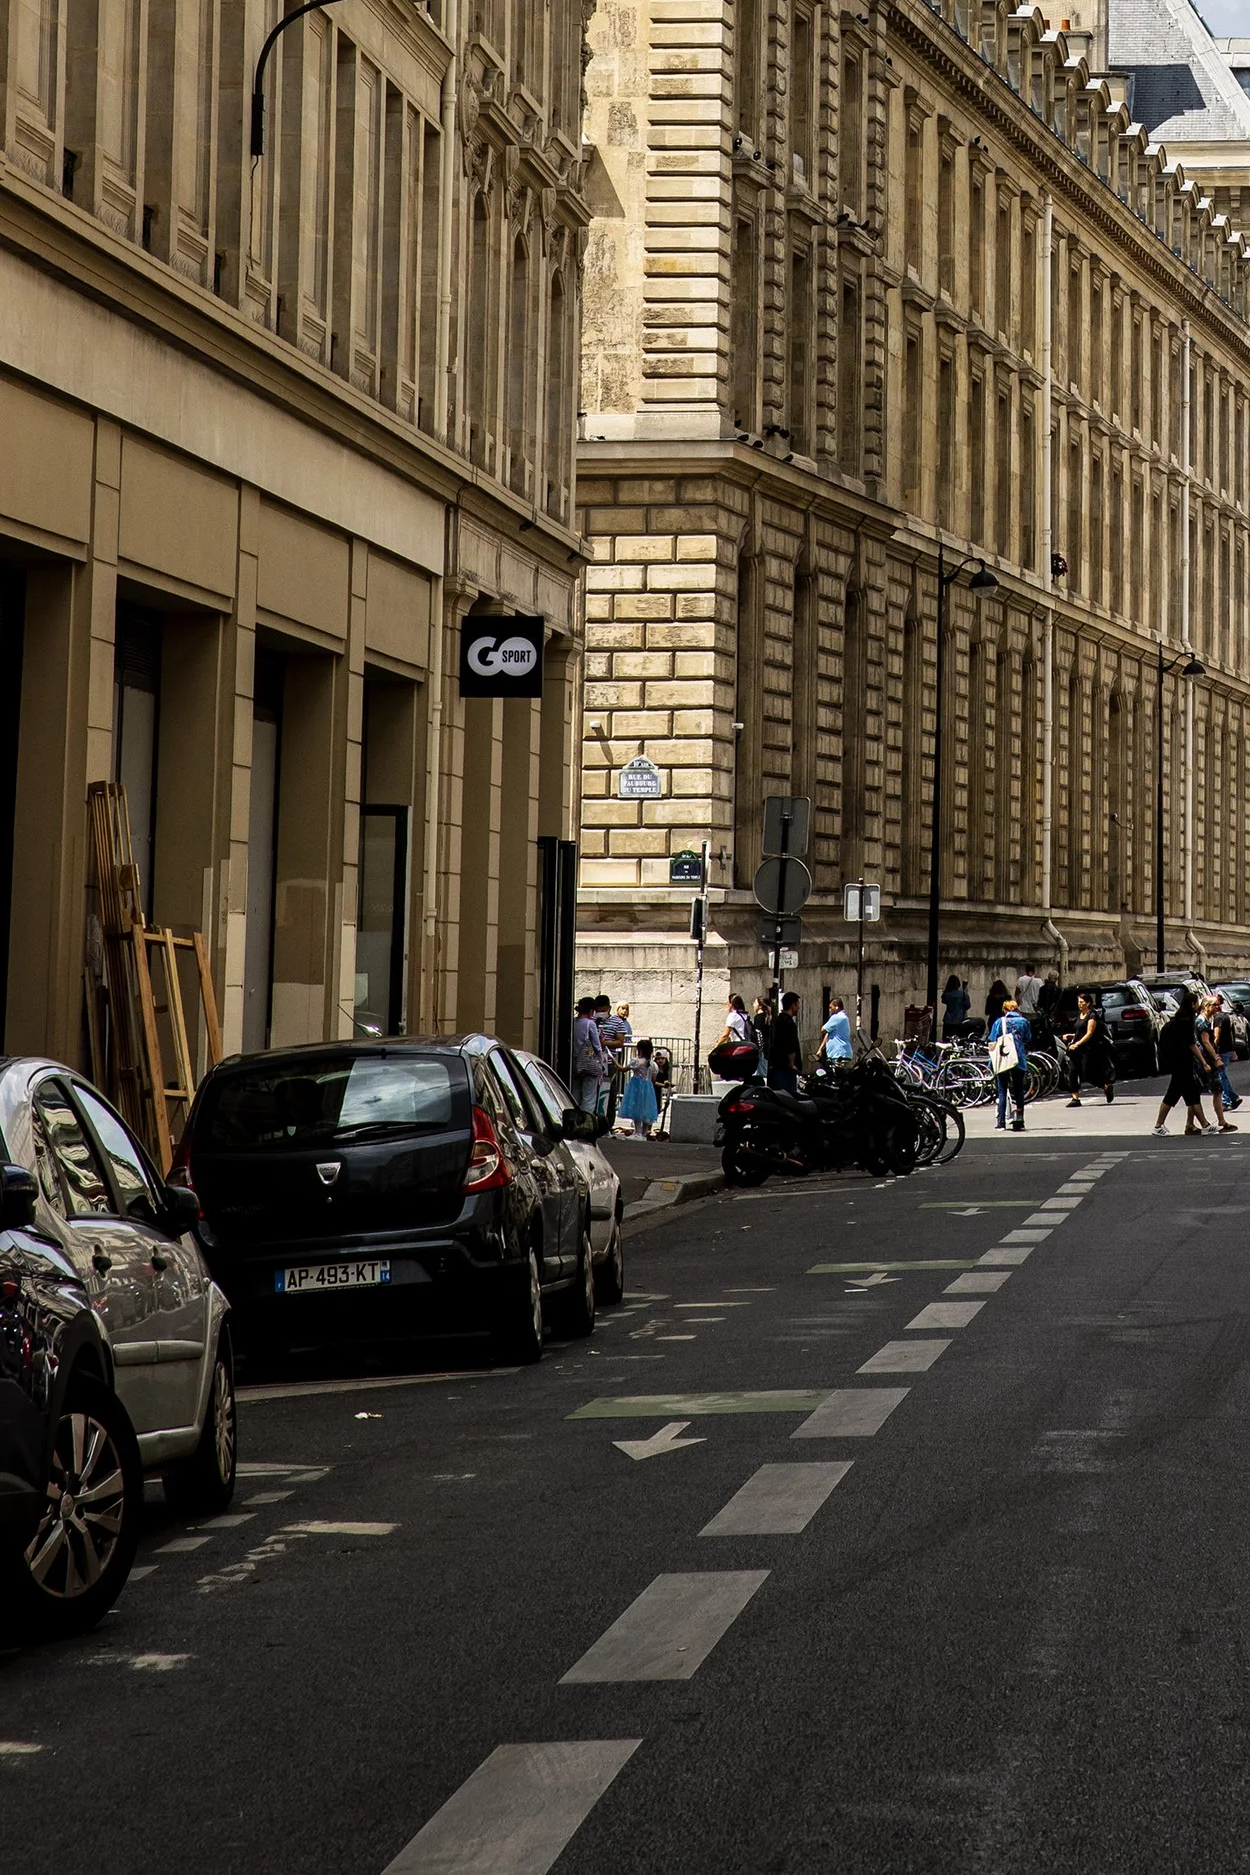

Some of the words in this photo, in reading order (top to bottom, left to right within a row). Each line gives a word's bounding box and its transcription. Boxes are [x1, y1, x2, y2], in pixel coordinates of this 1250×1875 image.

[467, 636, 537, 677] GO
[501, 650, 532, 663] SPORT
[286, 1263, 379, 1289] AP-493-KT
[381, 1271, 390, 1281] 14
